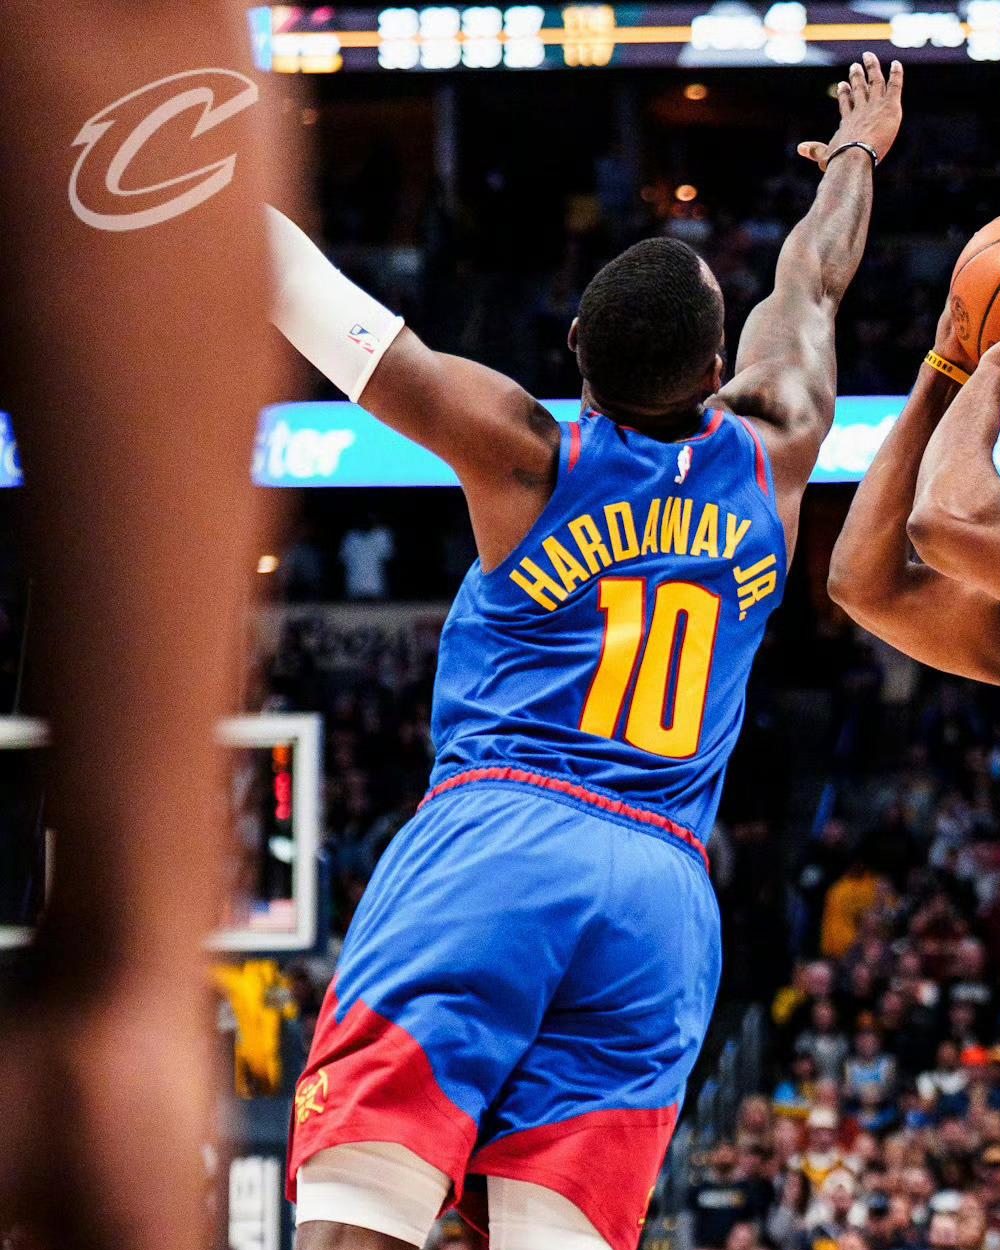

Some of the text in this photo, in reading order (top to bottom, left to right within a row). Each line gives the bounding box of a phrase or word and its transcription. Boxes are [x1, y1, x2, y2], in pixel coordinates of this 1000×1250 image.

[508, 496, 778, 623] HARDAWAY JR.
[578, 576, 722, 761] 10
